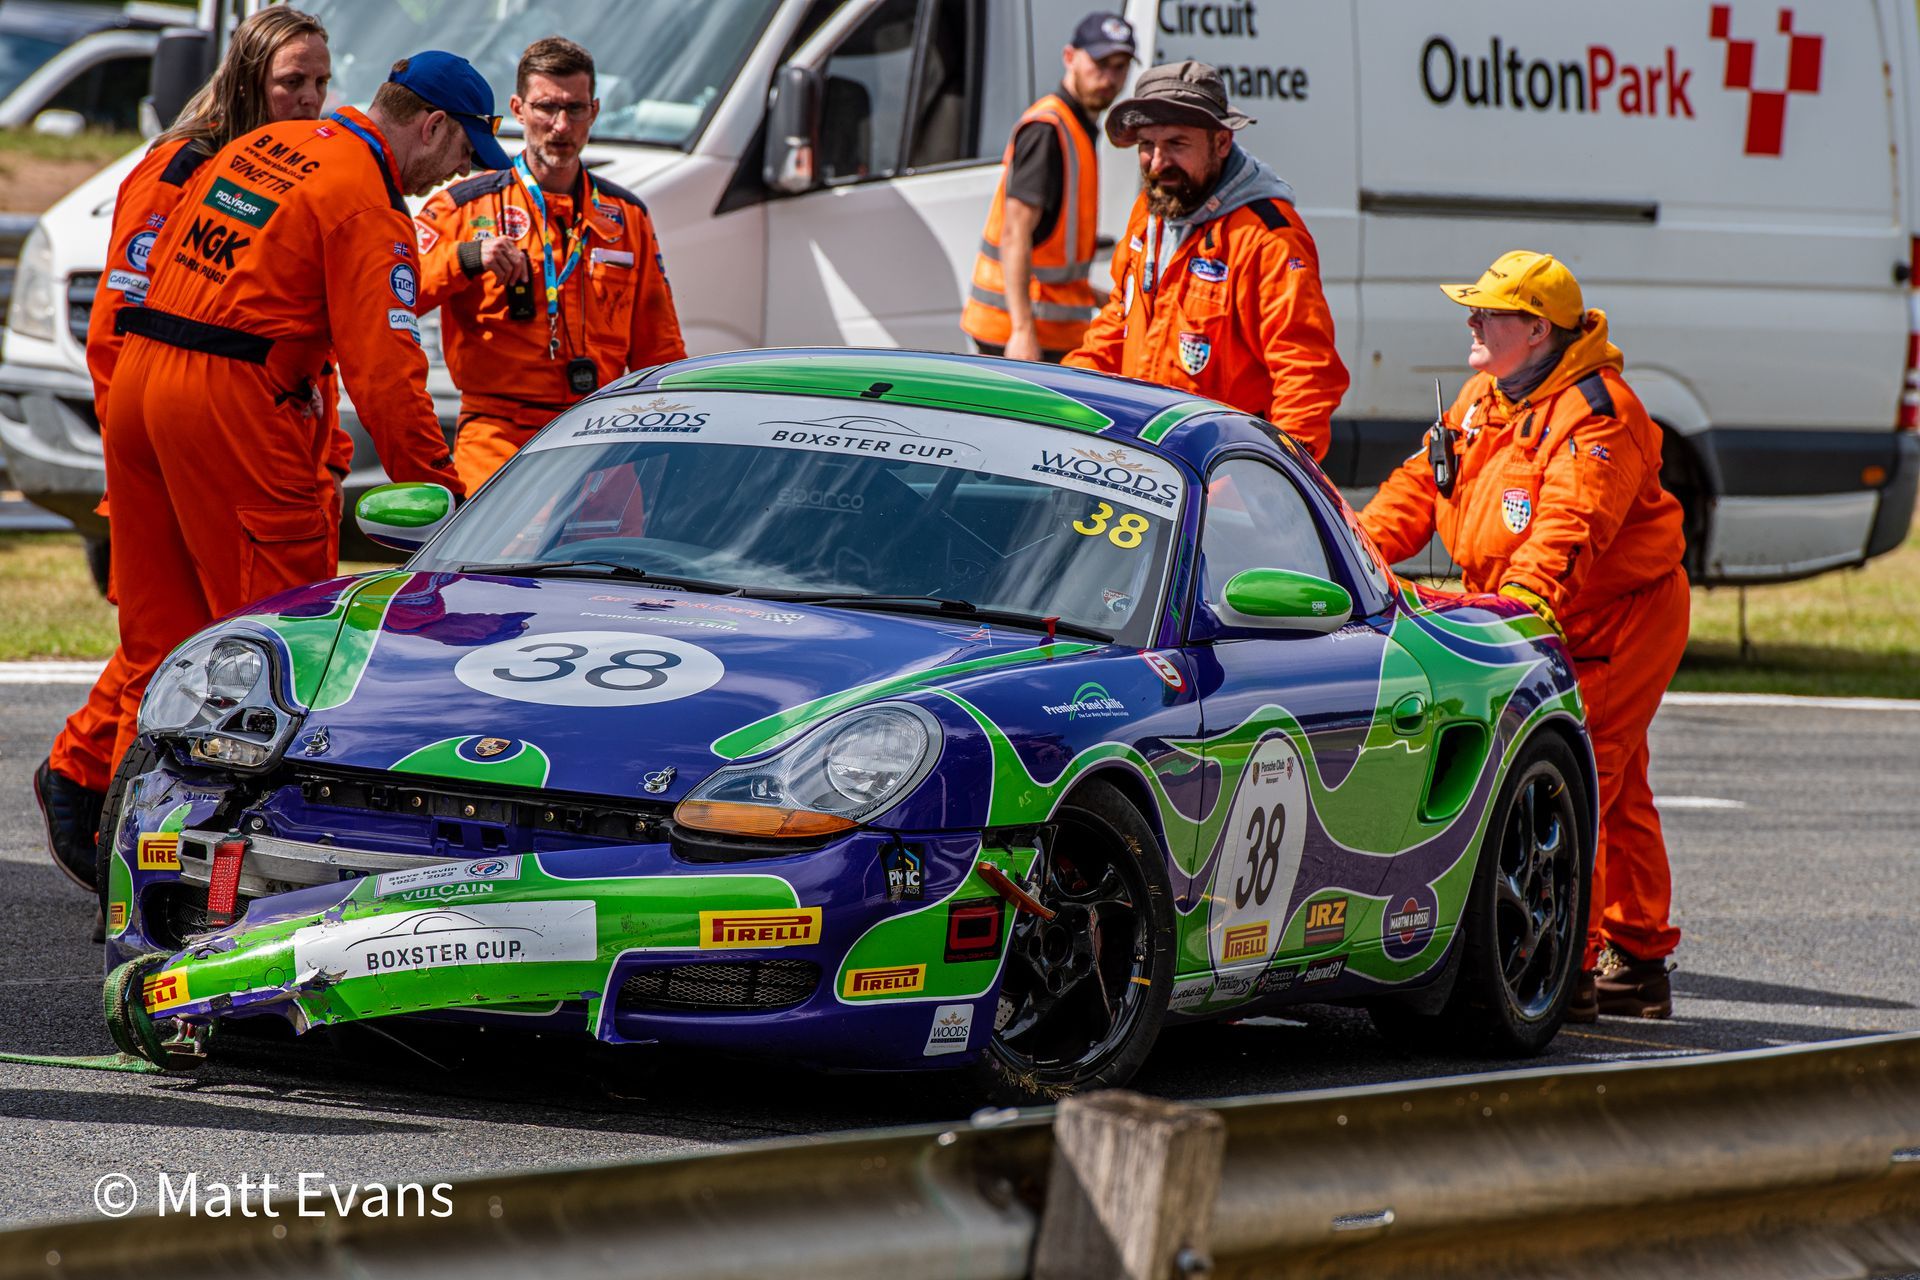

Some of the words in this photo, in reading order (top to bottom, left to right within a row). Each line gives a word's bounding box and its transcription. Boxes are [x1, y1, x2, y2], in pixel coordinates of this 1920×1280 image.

[1158, 0, 1257, 37] Circuit
[1421, 34, 1695, 119] OultonPark
[230, 155, 295, 194] GINETTA
[215, 190, 259, 215] POLYFLOR
[181, 215, 250, 271] NGK
[584, 412, 711, 430] WOODS
[627, 426, 699, 434] SERVICE
[771, 430, 891, 452] BOXSTER
[1037, 465, 1085, 480] FOOD
[1094, 479, 1168, 507] SERVICE
[1041, 450, 1178, 500] WOODS
[1072, 502, 1150, 549] 38
[580, 612, 645, 620] Premier
[648, 617, 694, 625] Panel
[699, 622, 739, 631] Skills
[492, 642, 682, 691] 38
[1042, 702, 1078, 716] Premier
[1078, 700, 1101, 712] Panel
[1101, 697, 1125, 710] Skills
[1261, 761, 1276, 772] Porsche
[1276, 759, 1285, 770] Club
[143, 840, 179, 863] PIRE
[1235, 803, 1286, 910] 38
[427, 872, 454, 880] 2022
[402, 883, 494, 901] VULCAIN
[1307, 901, 1346, 929] JRZ
[1391, 914, 1409, 930] MARTINI
[1414, 912, 1430, 926] ROSSI
[712, 915, 813, 942] PIRELLI
[1224, 925, 1268, 959] PIRELLI
[366, 943, 467, 970] BOXSTER
[852, 967, 920, 992] PIRELLI
[1304, 960, 1343, 983] stand21
[933, 1025, 969, 1038] WOODS
